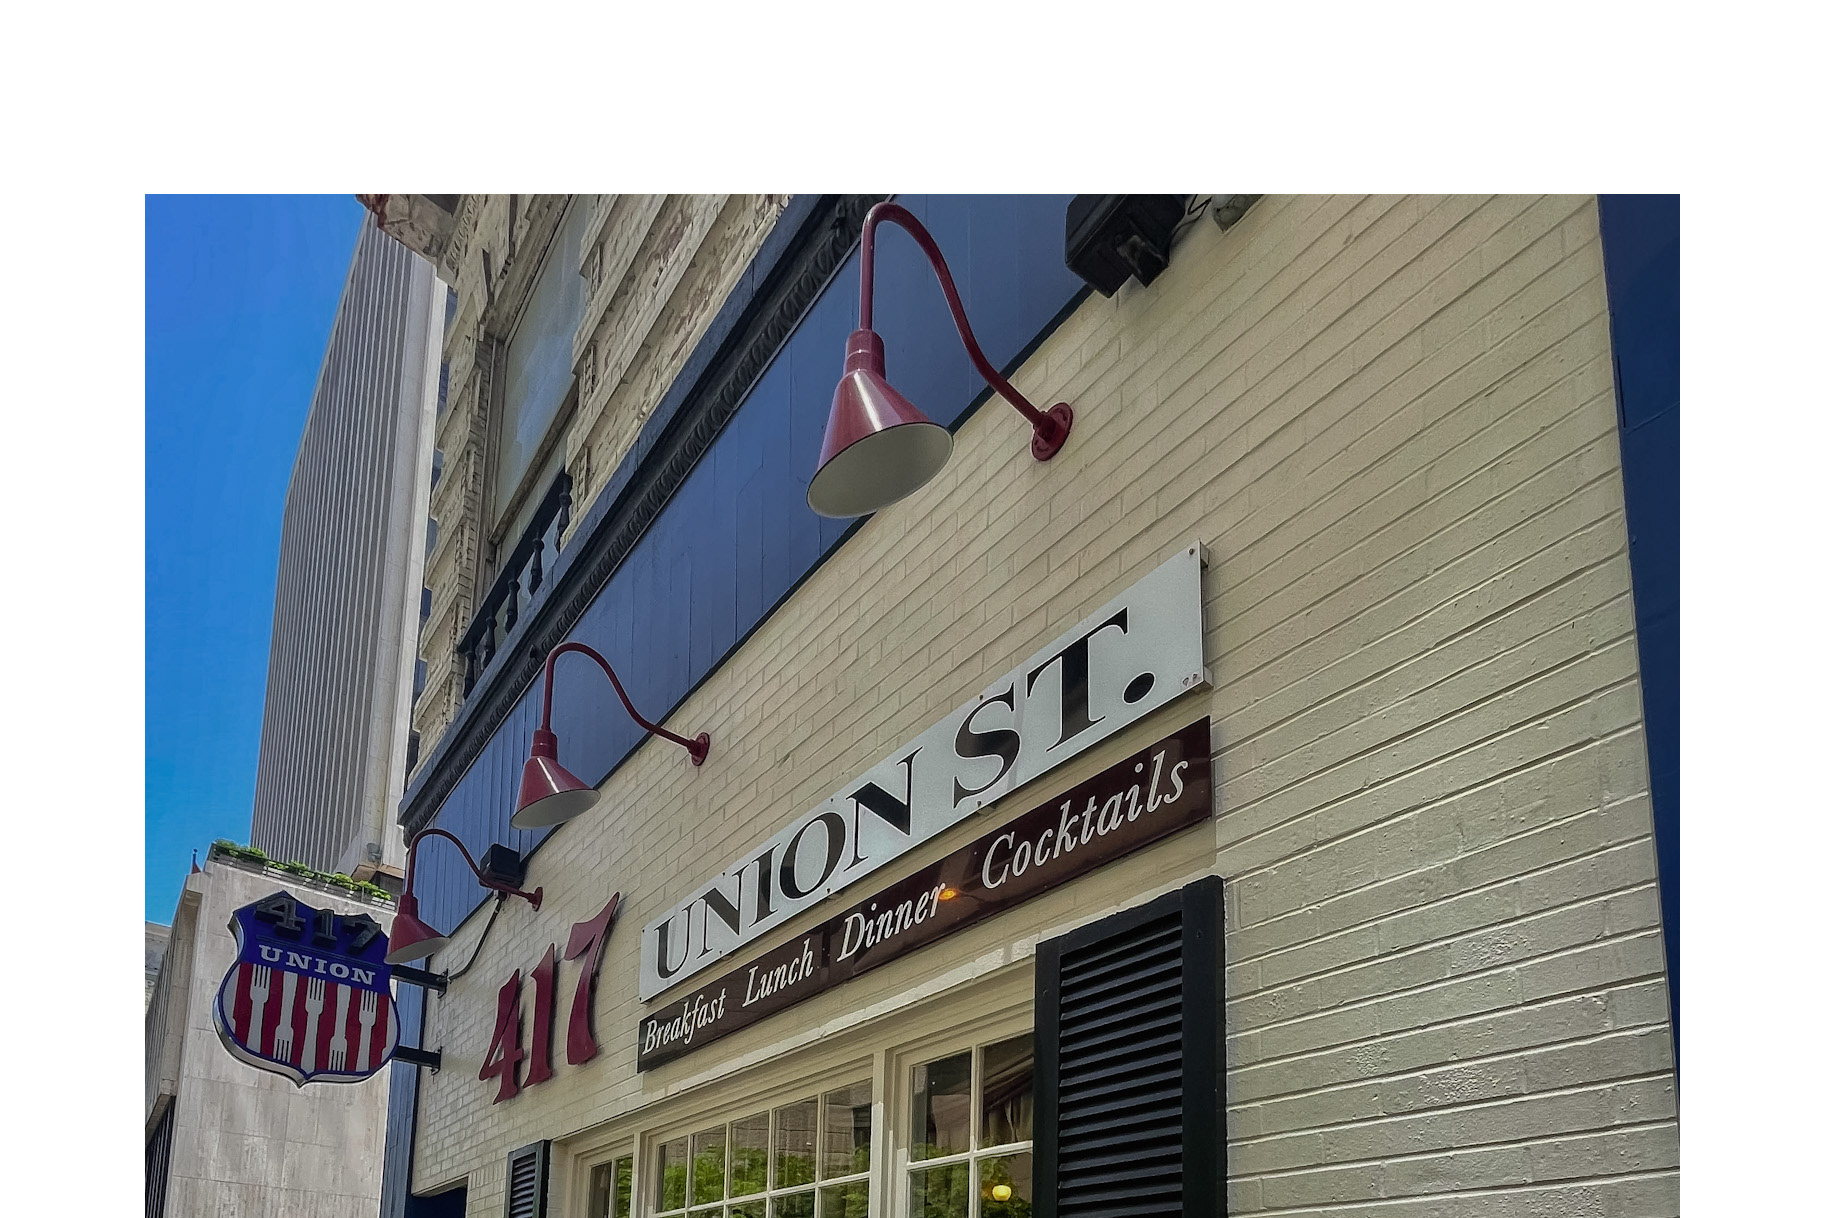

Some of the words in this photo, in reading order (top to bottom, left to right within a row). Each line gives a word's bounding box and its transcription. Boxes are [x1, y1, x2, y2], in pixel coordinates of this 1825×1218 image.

[653, 746, 924, 980] UNION
[952, 605, 1156, 810] ST.
[255, 896, 382, 953] 417
[258, 944, 376, 986] UNION
[479, 891, 621, 1106] 417
[642, 987, 726, 1055] Breakfast
[741, 937, 814, 1007] Lunch
[836, 882, 946, 963] Dinner
[981, 749, 1190, 890] Cocktails
